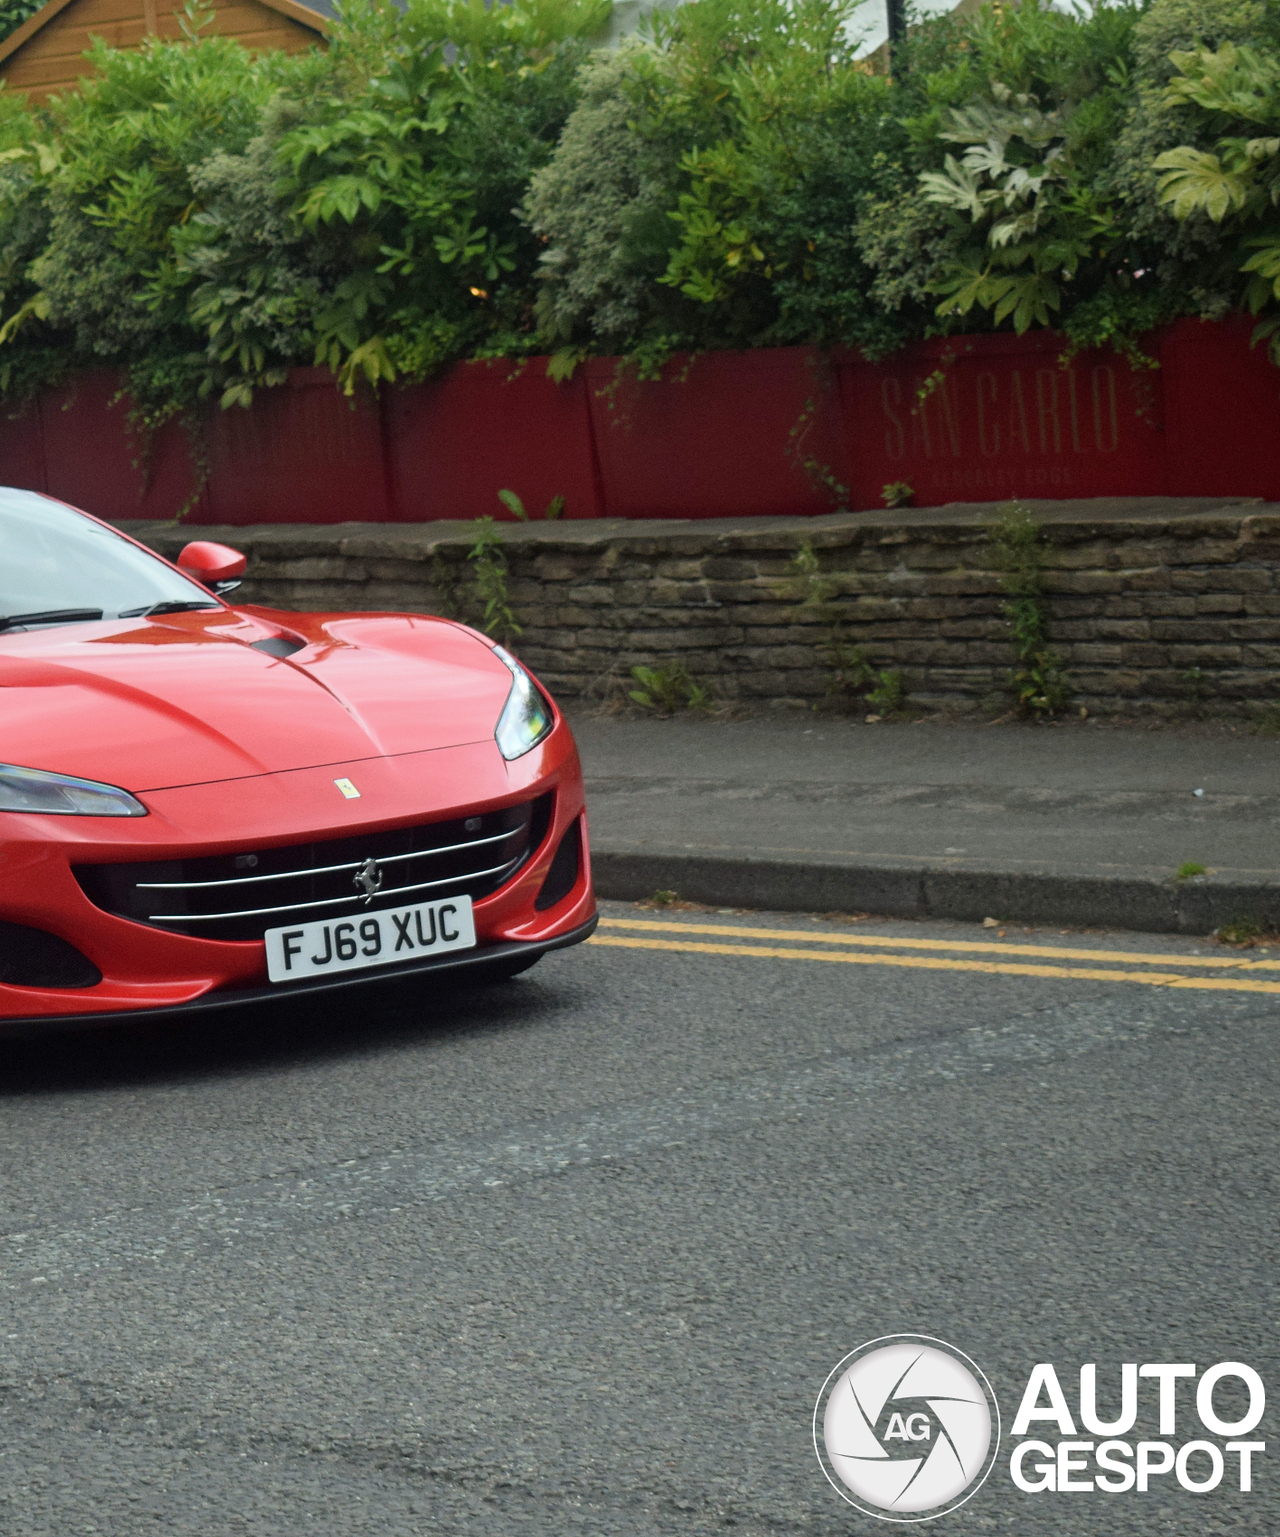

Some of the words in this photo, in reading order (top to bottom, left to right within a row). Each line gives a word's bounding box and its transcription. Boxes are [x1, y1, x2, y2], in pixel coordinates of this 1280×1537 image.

[882, 374, 961, 459] SAN
[976, 365, 1120, 457] CARLO
[281, 918, 382, 970] FJ69
[391, 904, 459, 952] XUC
